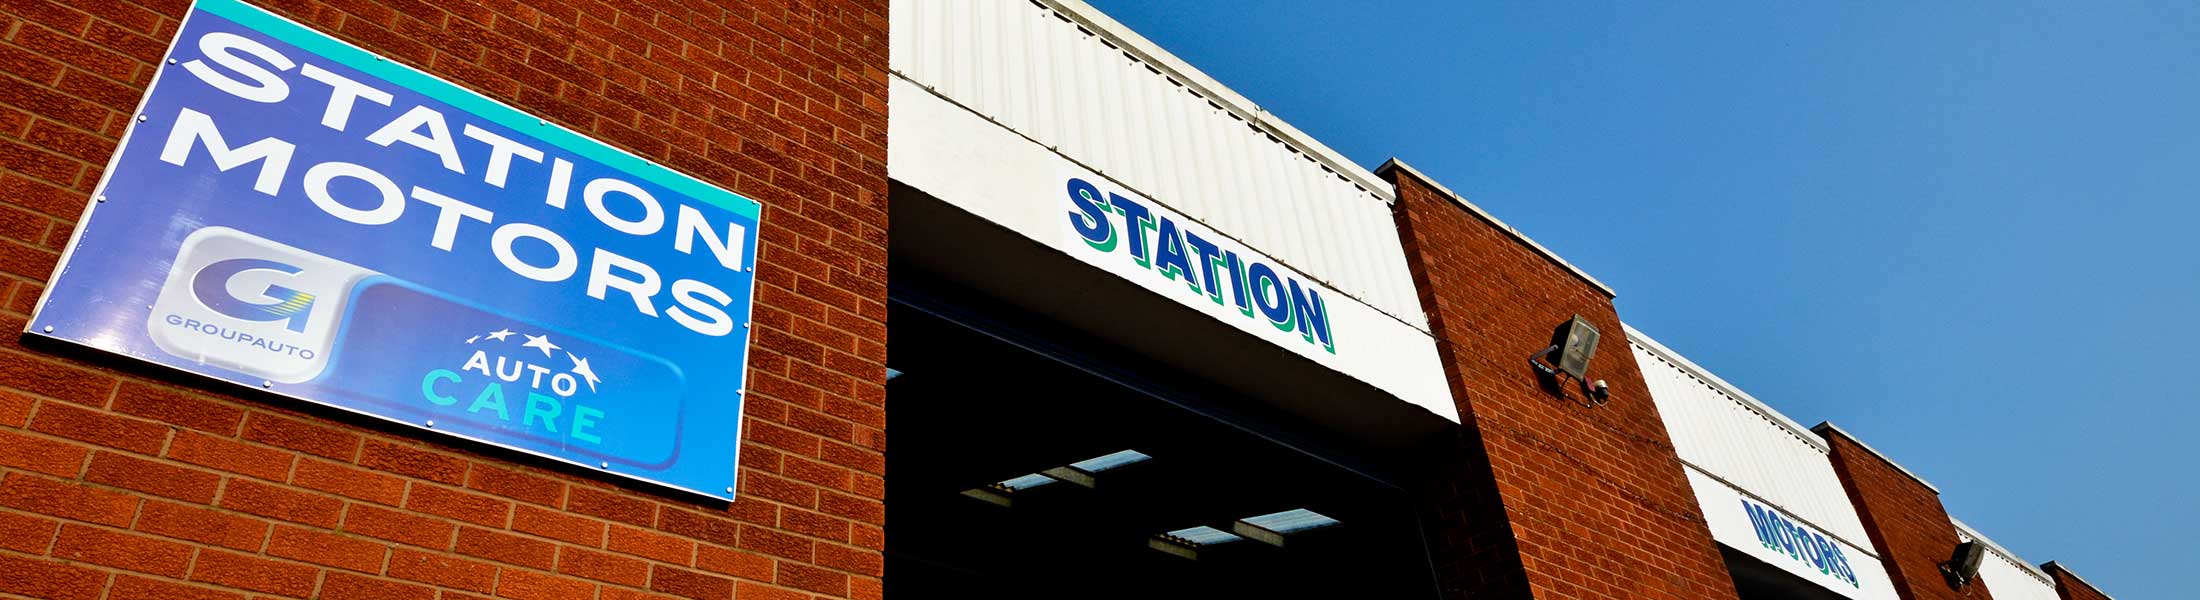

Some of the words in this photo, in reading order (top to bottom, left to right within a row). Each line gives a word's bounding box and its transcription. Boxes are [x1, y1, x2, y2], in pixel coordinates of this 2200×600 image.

[182, 32, 746, 271] STATION
[160, 107, 734, 337] MOTORS
[1067, 177, 1335, 354] STATION
[165, 314, 315, 360] GROUPAUTO
[461, 350, 578, 397] AUTO
[421, 368, 606, 445] CARE
[1740, 499, 1859, 589] MOTORS
